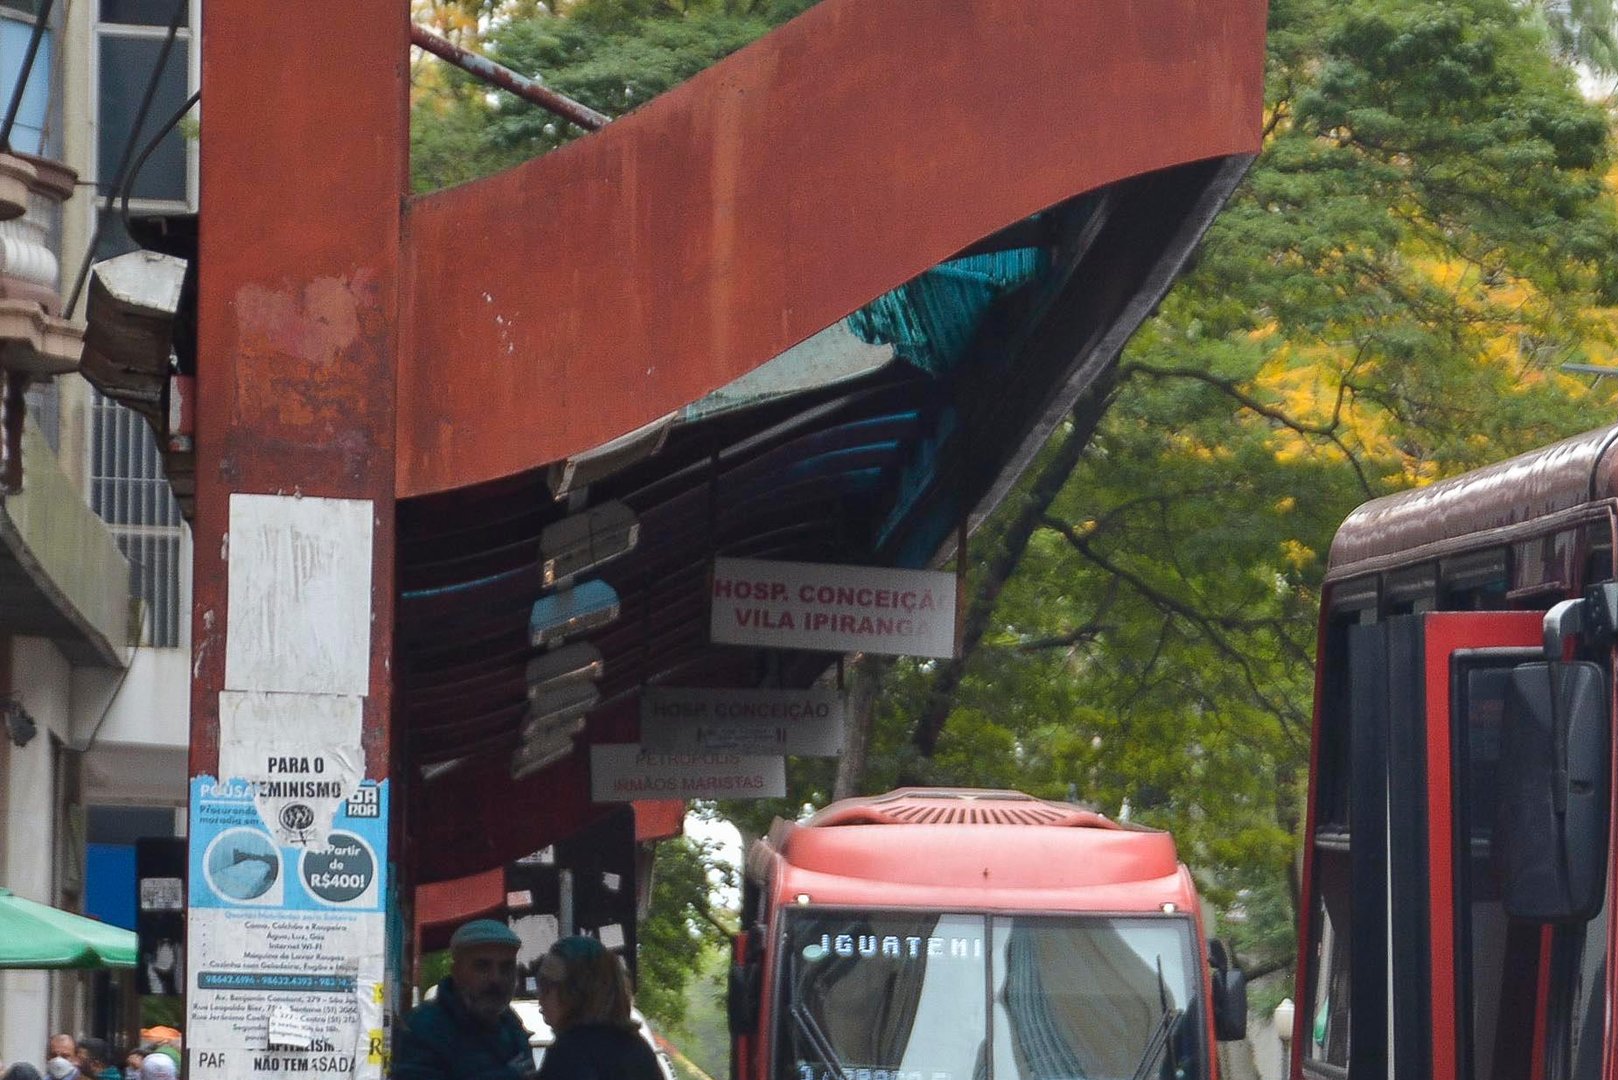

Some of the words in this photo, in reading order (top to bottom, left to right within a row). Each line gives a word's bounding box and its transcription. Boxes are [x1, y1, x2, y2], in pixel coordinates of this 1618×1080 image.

[713, 578, 789, 601] HOSP.
[799, 584, 938, 613] CONCEIÇÃ
[735, 607, 796, 631] VILA
[268, 757, 310, 774] PARA
[314, 757, 325, 774] O
[252, 781, 342, 799] EMINISMO
[328, 858, 345, 871] de
[310, 872, 366, 889] R$400!
[821, 933, 982, 959] IGUATEMI
[254, 1055, 280, 1072] NÃO
[283, 1057, 308, 1072] TEM
